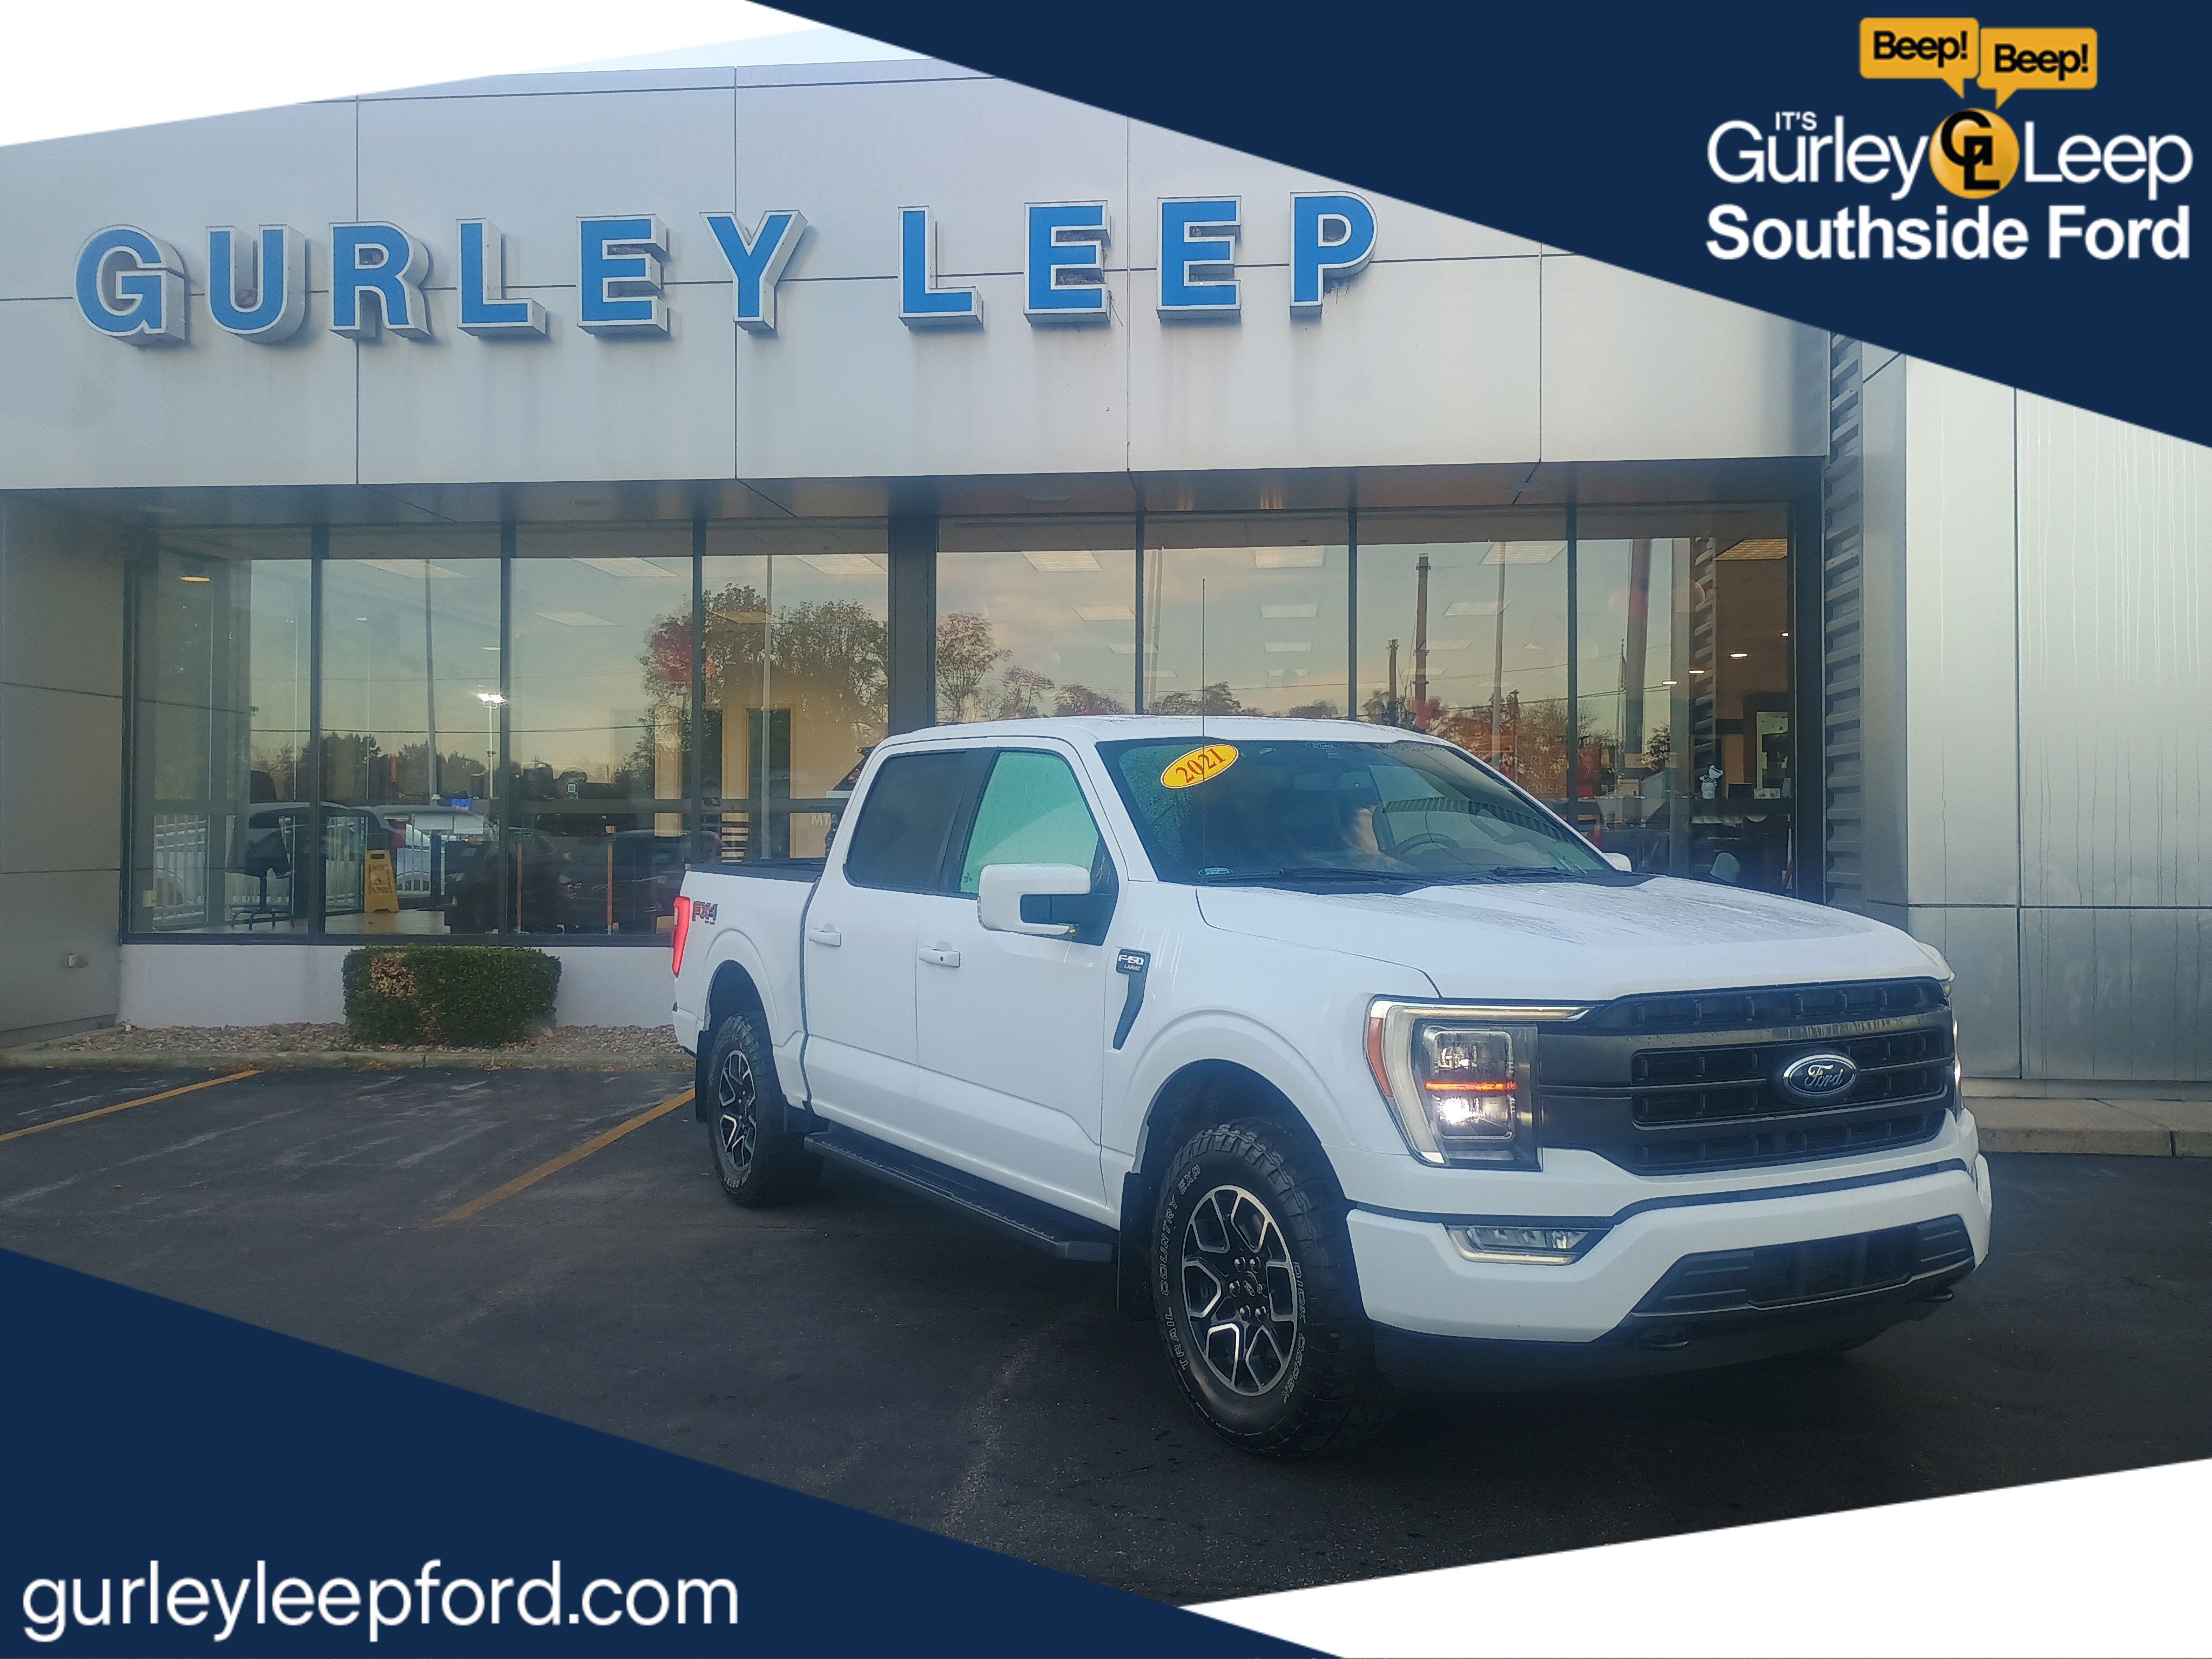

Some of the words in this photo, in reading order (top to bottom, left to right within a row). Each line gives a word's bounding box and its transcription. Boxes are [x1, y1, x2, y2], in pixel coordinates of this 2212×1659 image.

[74, 211, 806, 346] GURLEY
[898, 191, 1379, 326] LEEP
[1176, 748, 1226, 783] 2021
[1526, 784, 1562, 794] CRISP
[692, 901, 718, 921] FX4
[1804, 1064, 1844, 1088] Ford
[1177, 1164, 1202, 1196] EXP
[1159, 1192, 1178, 1297] COUNTRY
[1164, 1306, 1189, 1372] TRAIL
